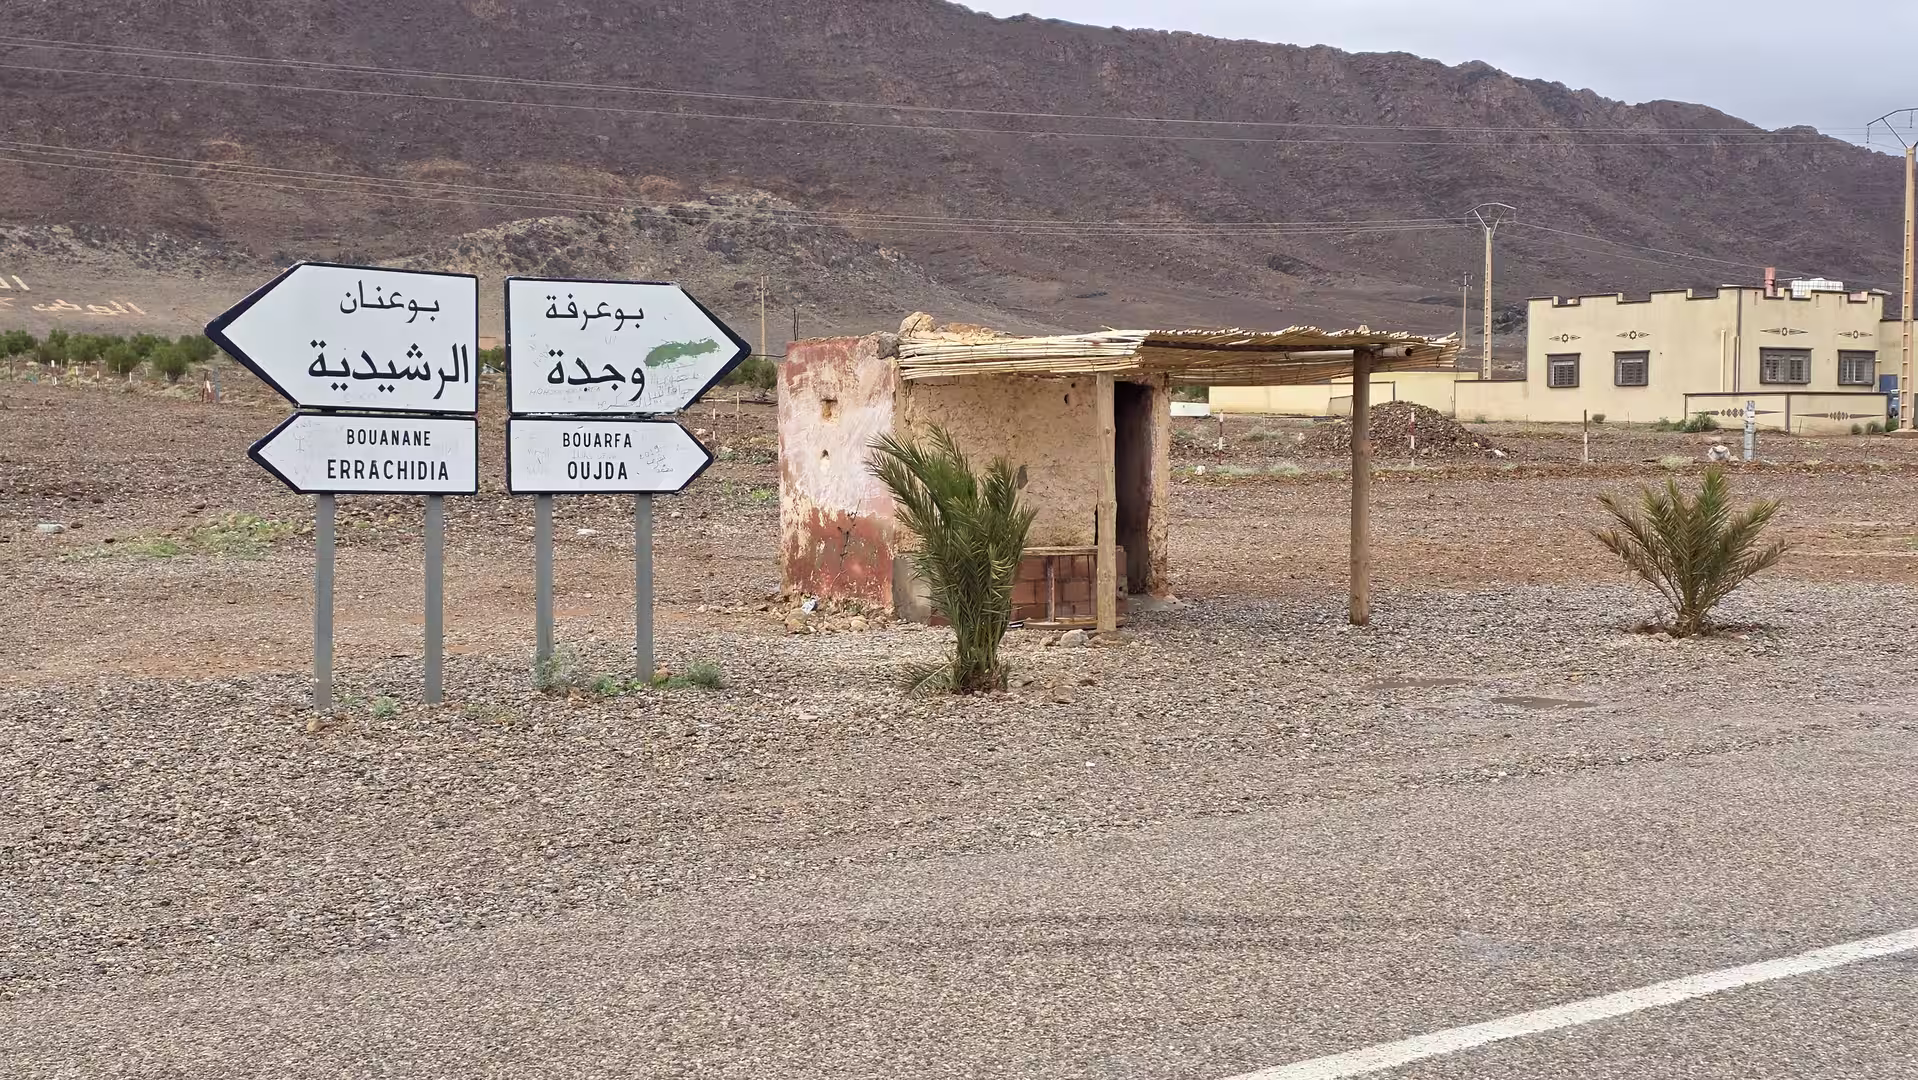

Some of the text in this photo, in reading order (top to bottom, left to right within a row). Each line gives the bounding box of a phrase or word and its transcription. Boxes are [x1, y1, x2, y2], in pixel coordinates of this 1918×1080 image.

[339, 280, 440, 324] بوعنان
[545, 293, 645, 332] بوعرفة
[308, 339, 469, 400] الرشيدية
[547, 349, 645, 402] وجدة
[346, 428, 431, 447] BOUANANE
[562, 432, 632, 448] BOUARFA
[327, 459, 449, 481] ERRACHIDIA
[567, 461, 628, 480] OUJDA
